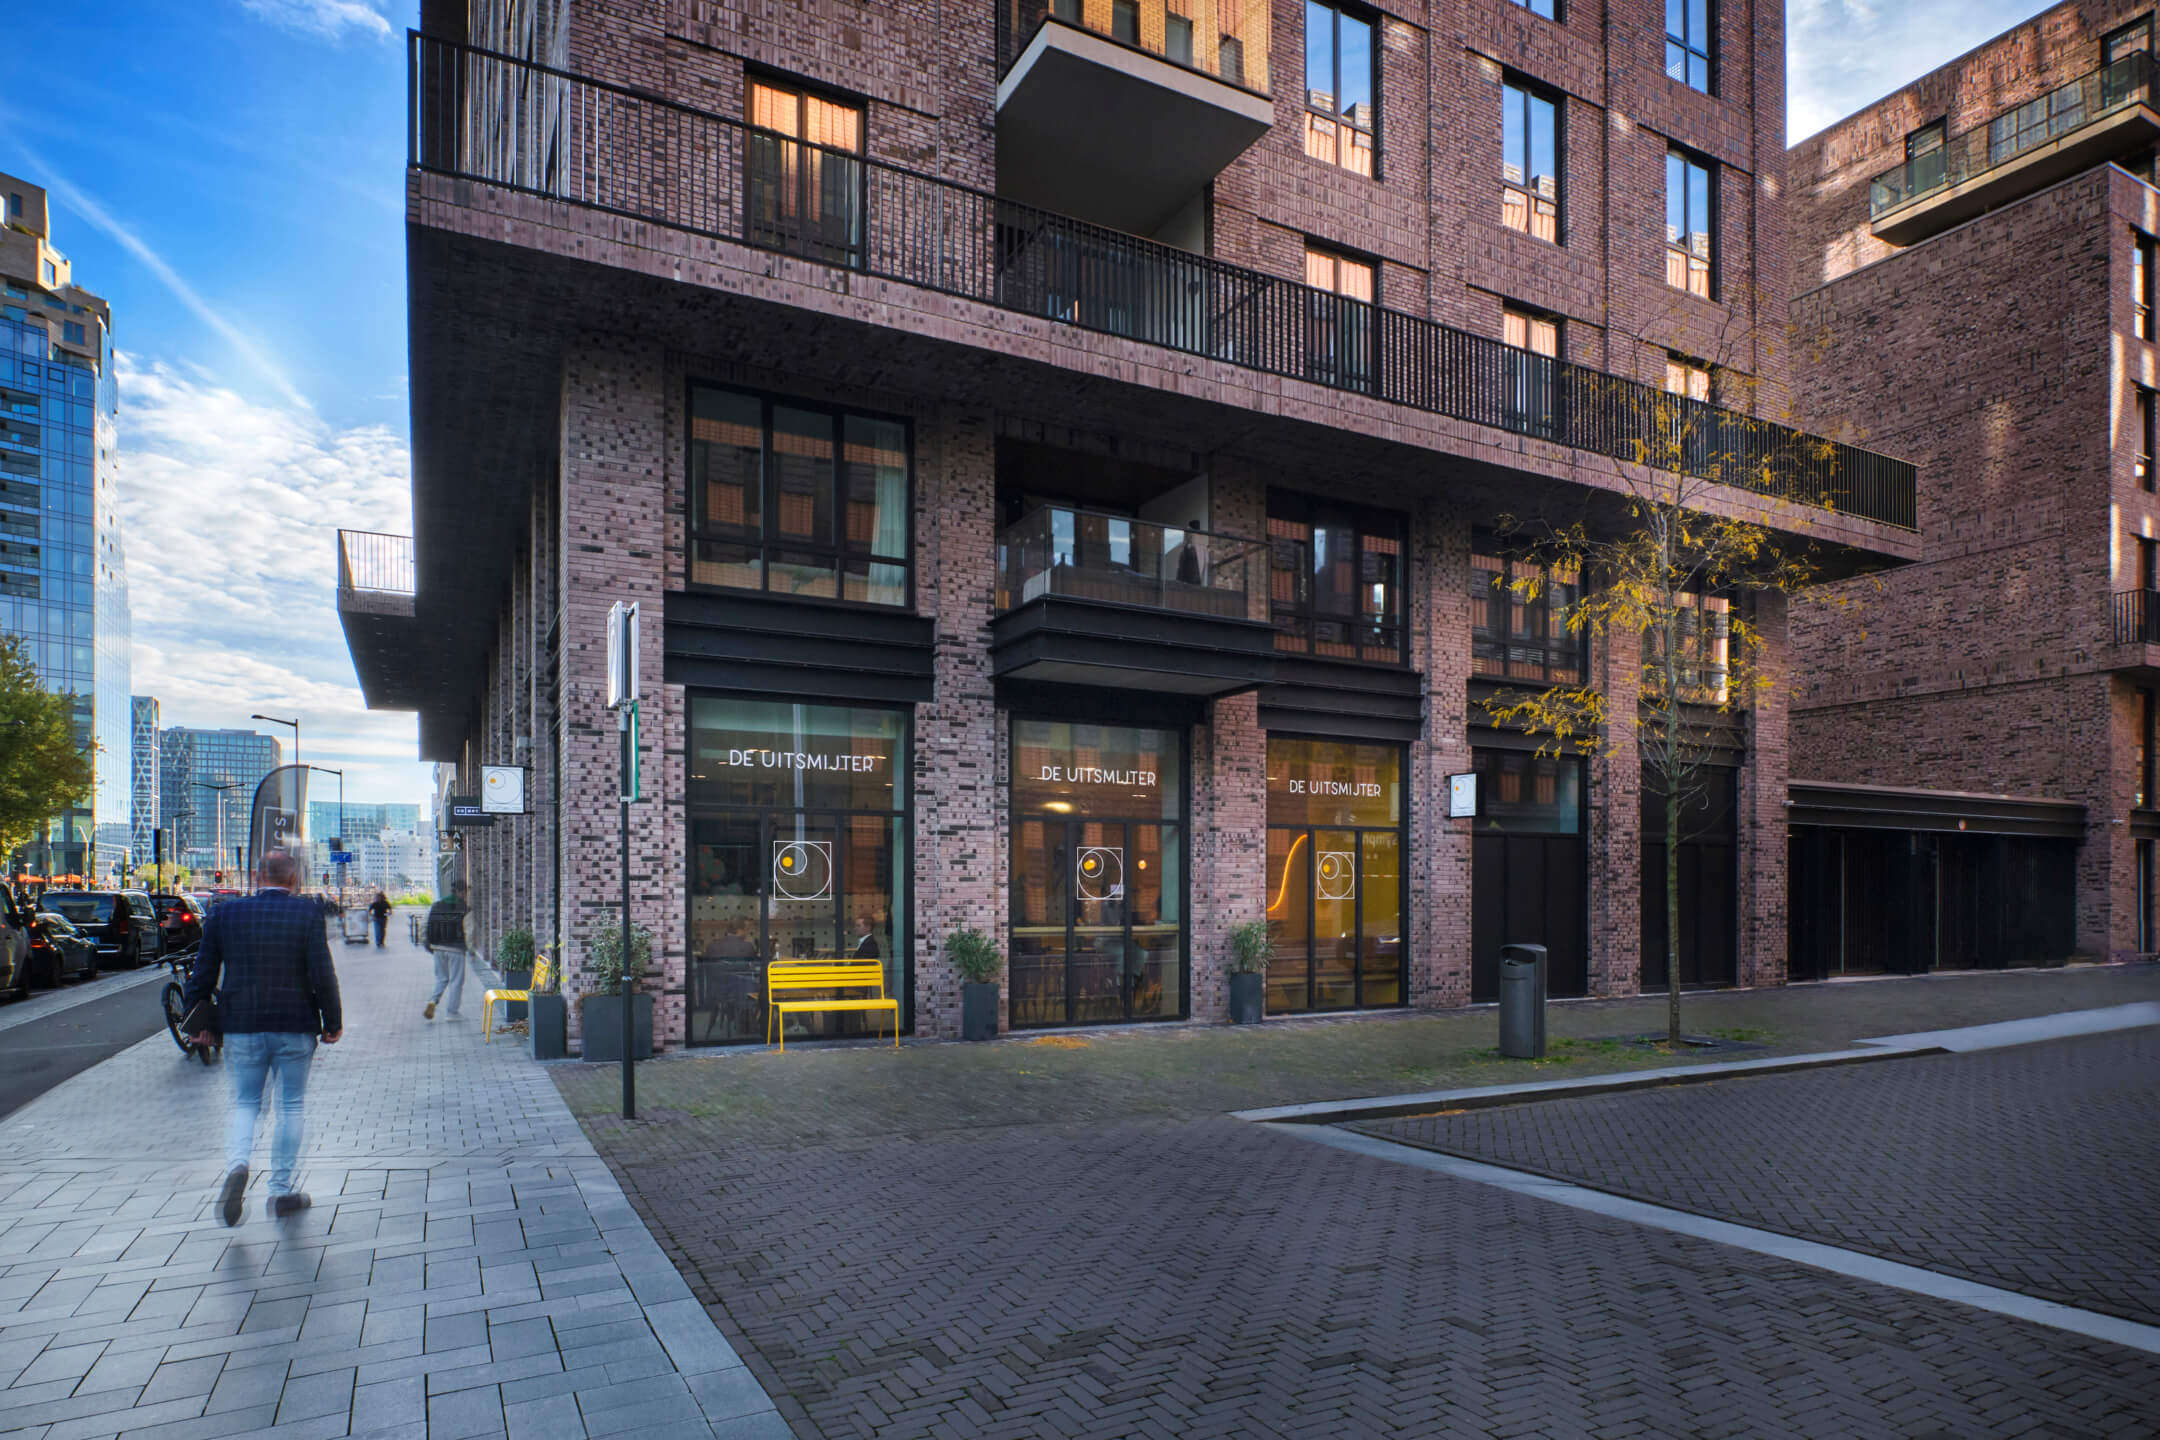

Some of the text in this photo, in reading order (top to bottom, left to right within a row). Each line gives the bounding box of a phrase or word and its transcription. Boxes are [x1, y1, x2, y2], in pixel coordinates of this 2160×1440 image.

[729, 750, 873, 772] DE UITSMIJTER
[1041, 766, 1155, 786] DE UITSMIJTER
[1289, 780, 1381, 797] DE UITSMIJTER
